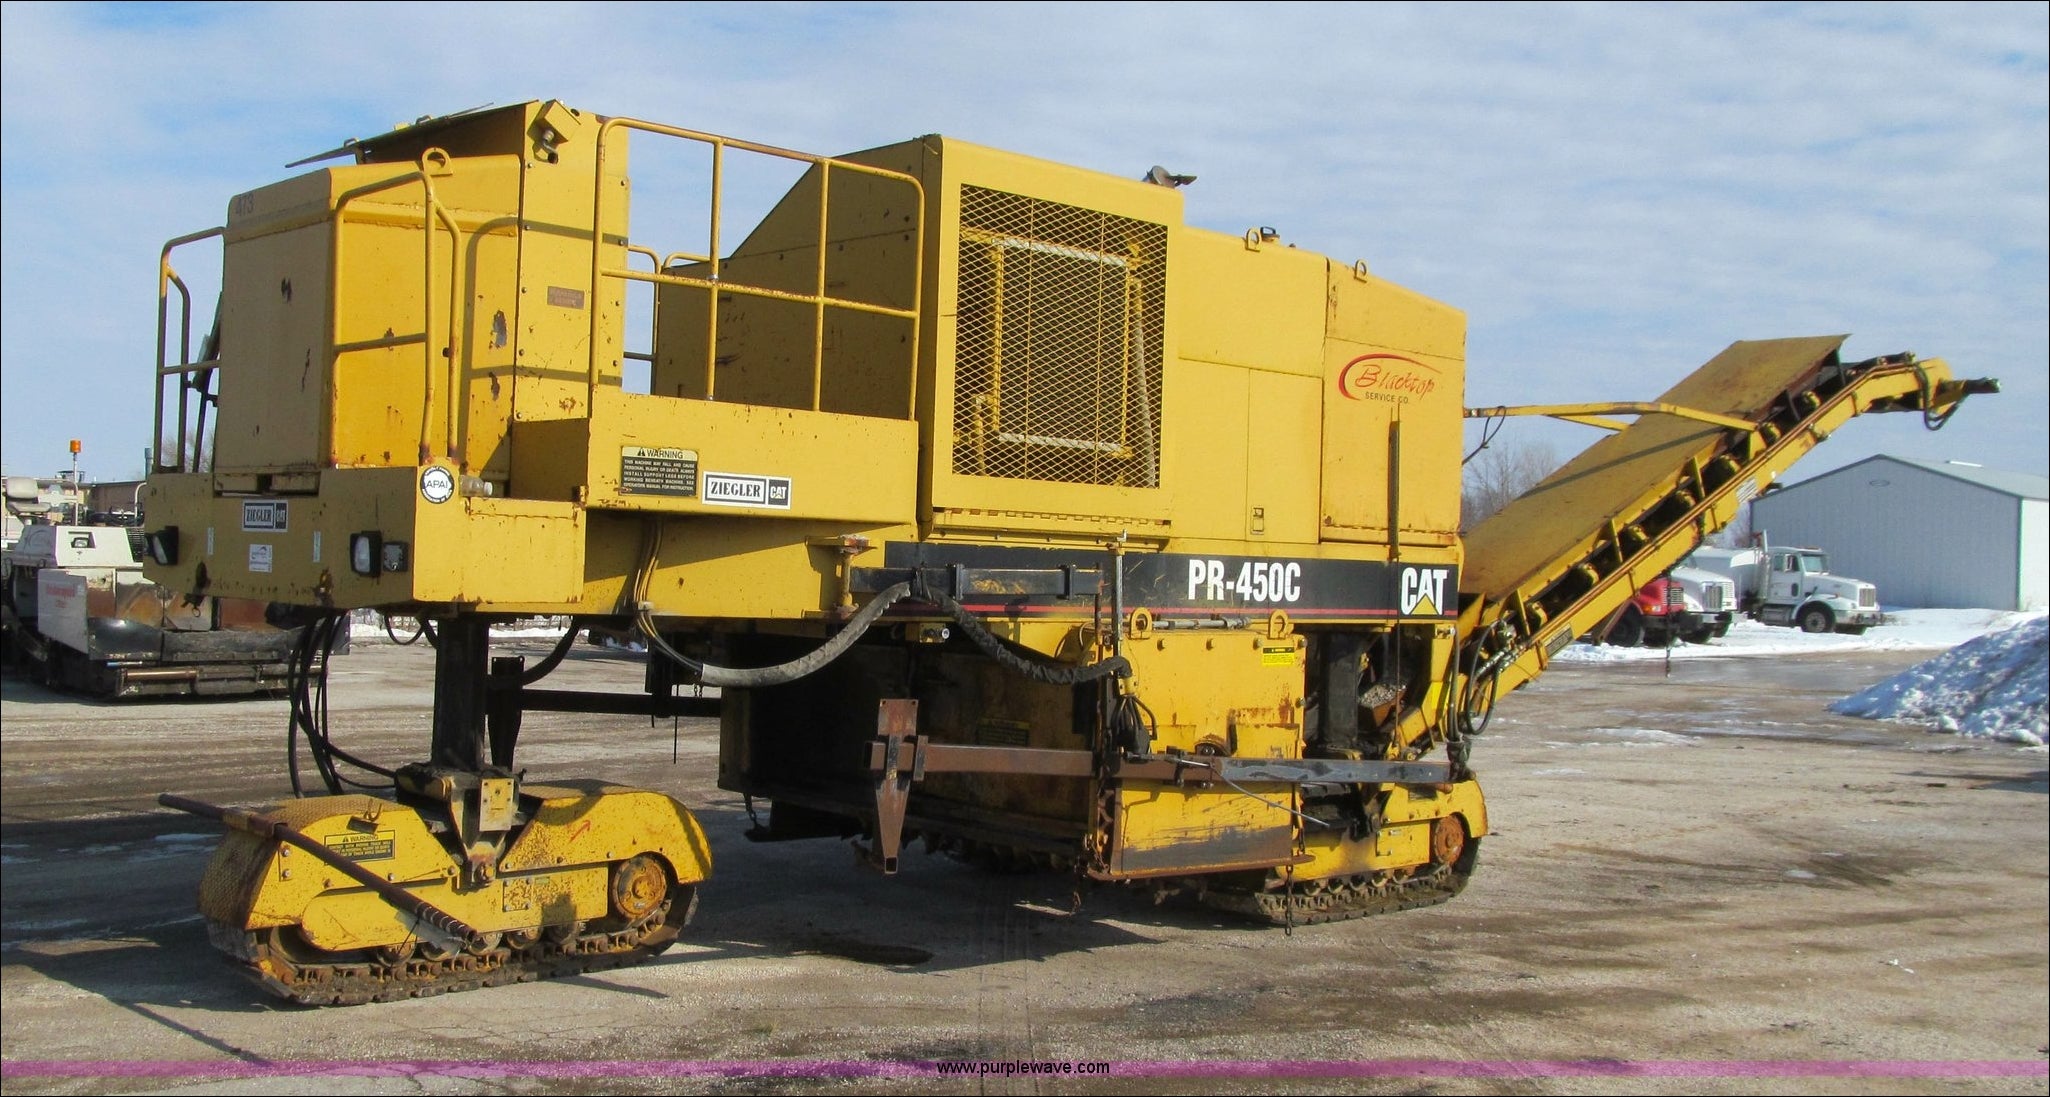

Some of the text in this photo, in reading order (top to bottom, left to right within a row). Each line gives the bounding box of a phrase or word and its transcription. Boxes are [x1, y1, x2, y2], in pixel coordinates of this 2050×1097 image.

[1365, 391, 1395, 402] SERVICE
[646, 448, 684, 459] WARNING
[426, 480, 448, 489] APAI
[710, 481, 787, 499] ZIEGLER CAT
[246, 509, 272, 522] ZIEGLER
[1188, 558, 1301, 602] PR-450C
[1401, 566, 1448, 615] CAT
